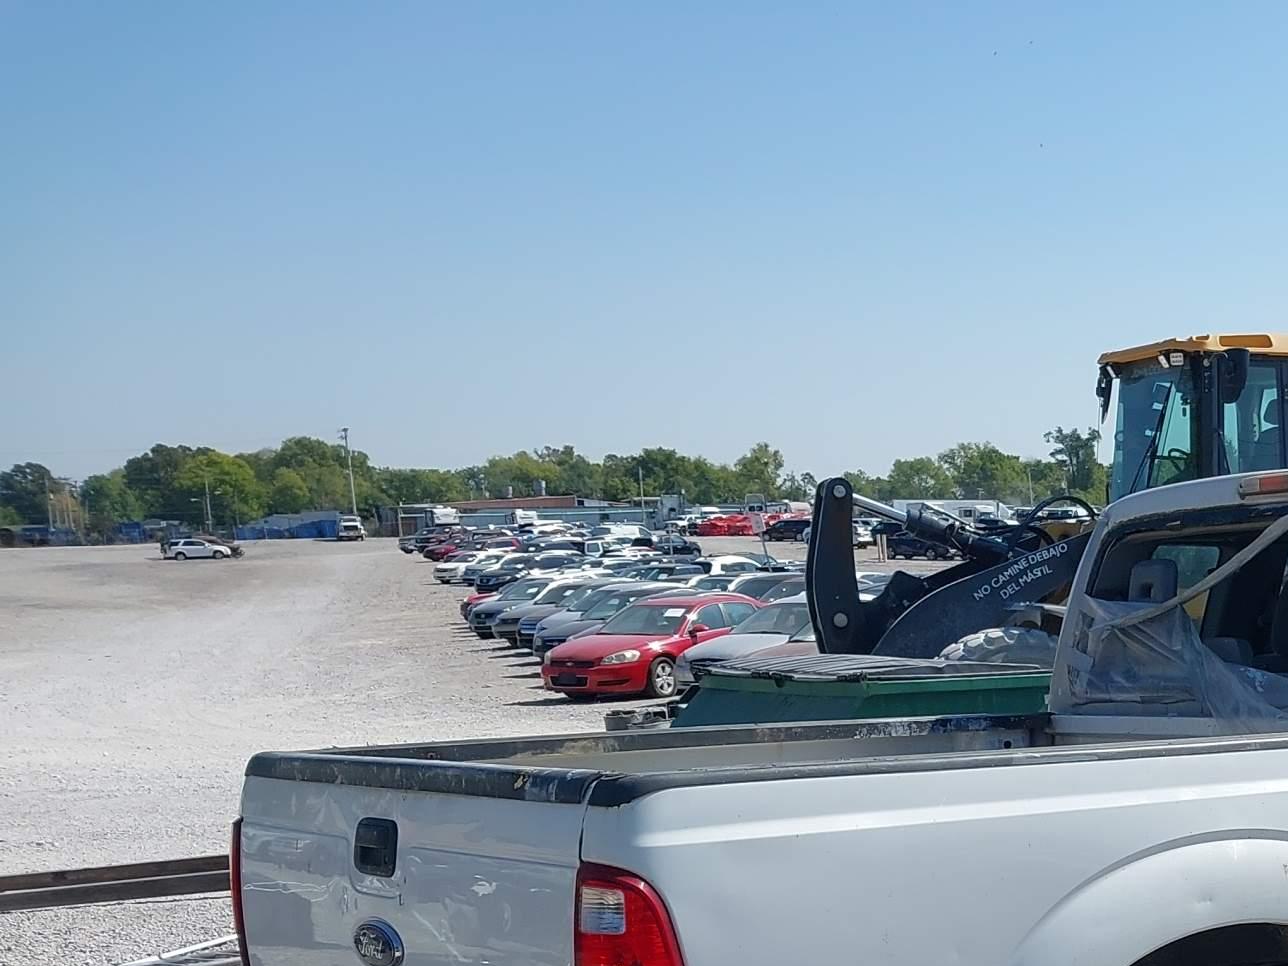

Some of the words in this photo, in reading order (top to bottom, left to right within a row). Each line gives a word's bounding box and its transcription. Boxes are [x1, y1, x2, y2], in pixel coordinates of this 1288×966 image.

[972, 584, 991, 601] NO
[991, 557, 1029, 588] CAMINE
[1028, 543, 1068, 565] DEBAJO
[999, 582, 1021, 600] DEL
[1020, 564, 1053, 587] MÁSTIL
